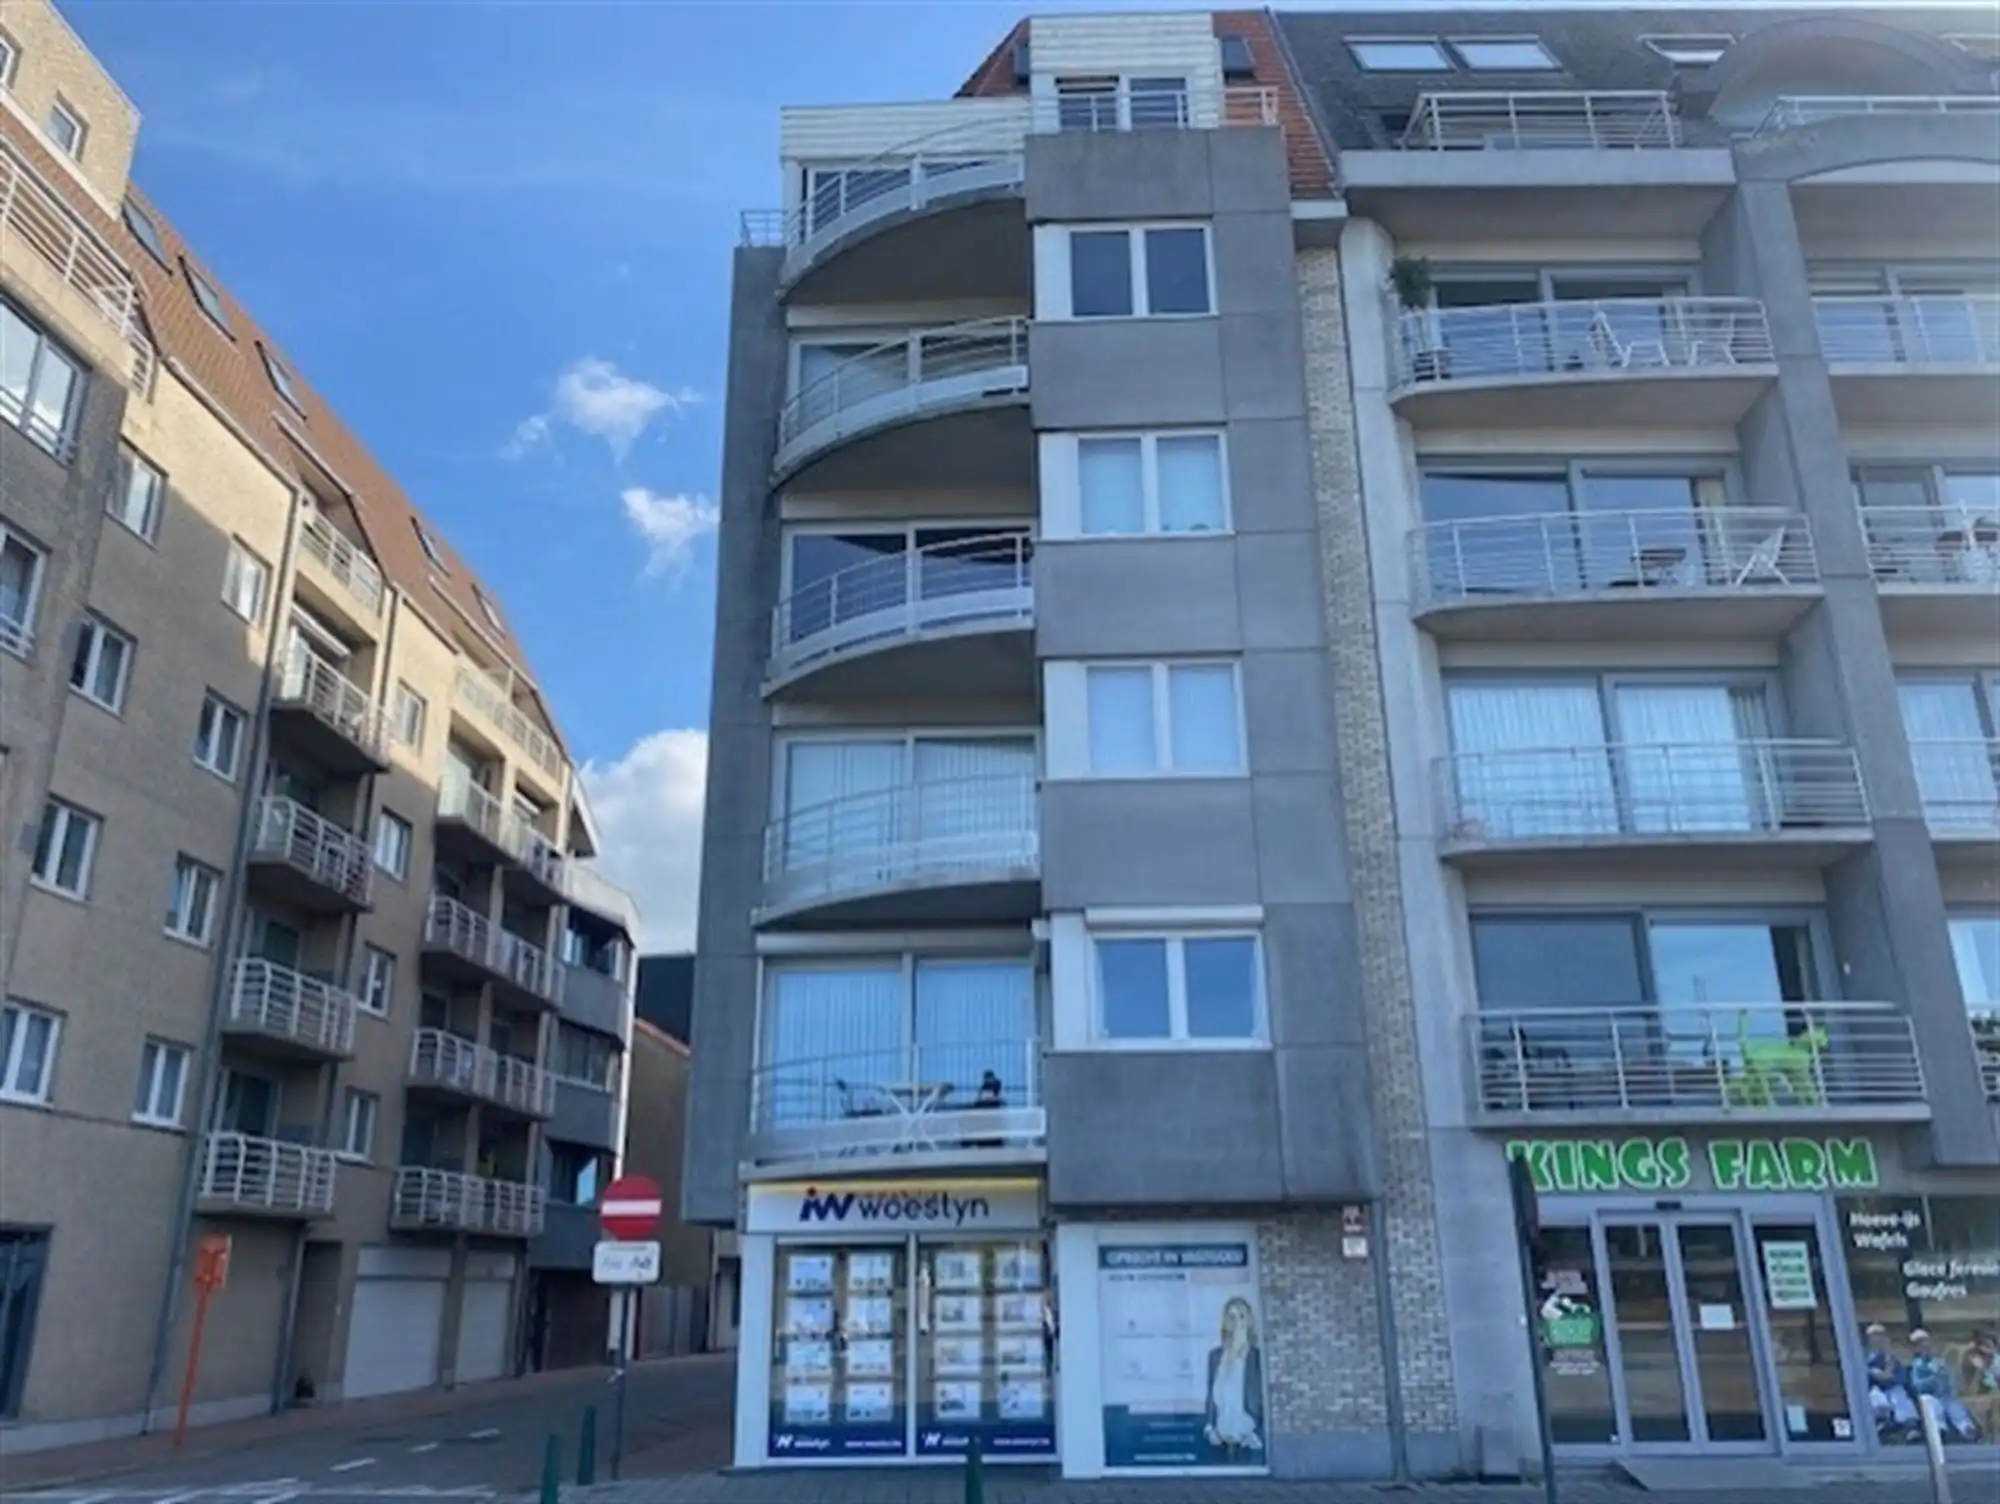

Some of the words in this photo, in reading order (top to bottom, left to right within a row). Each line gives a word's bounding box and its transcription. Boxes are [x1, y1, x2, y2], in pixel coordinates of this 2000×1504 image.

[1506, 1138, 1692, 1191] KINGS
[1708, 1137, 1880, 1190] FARM
[858, 1191, 990, 1227] woestyn
